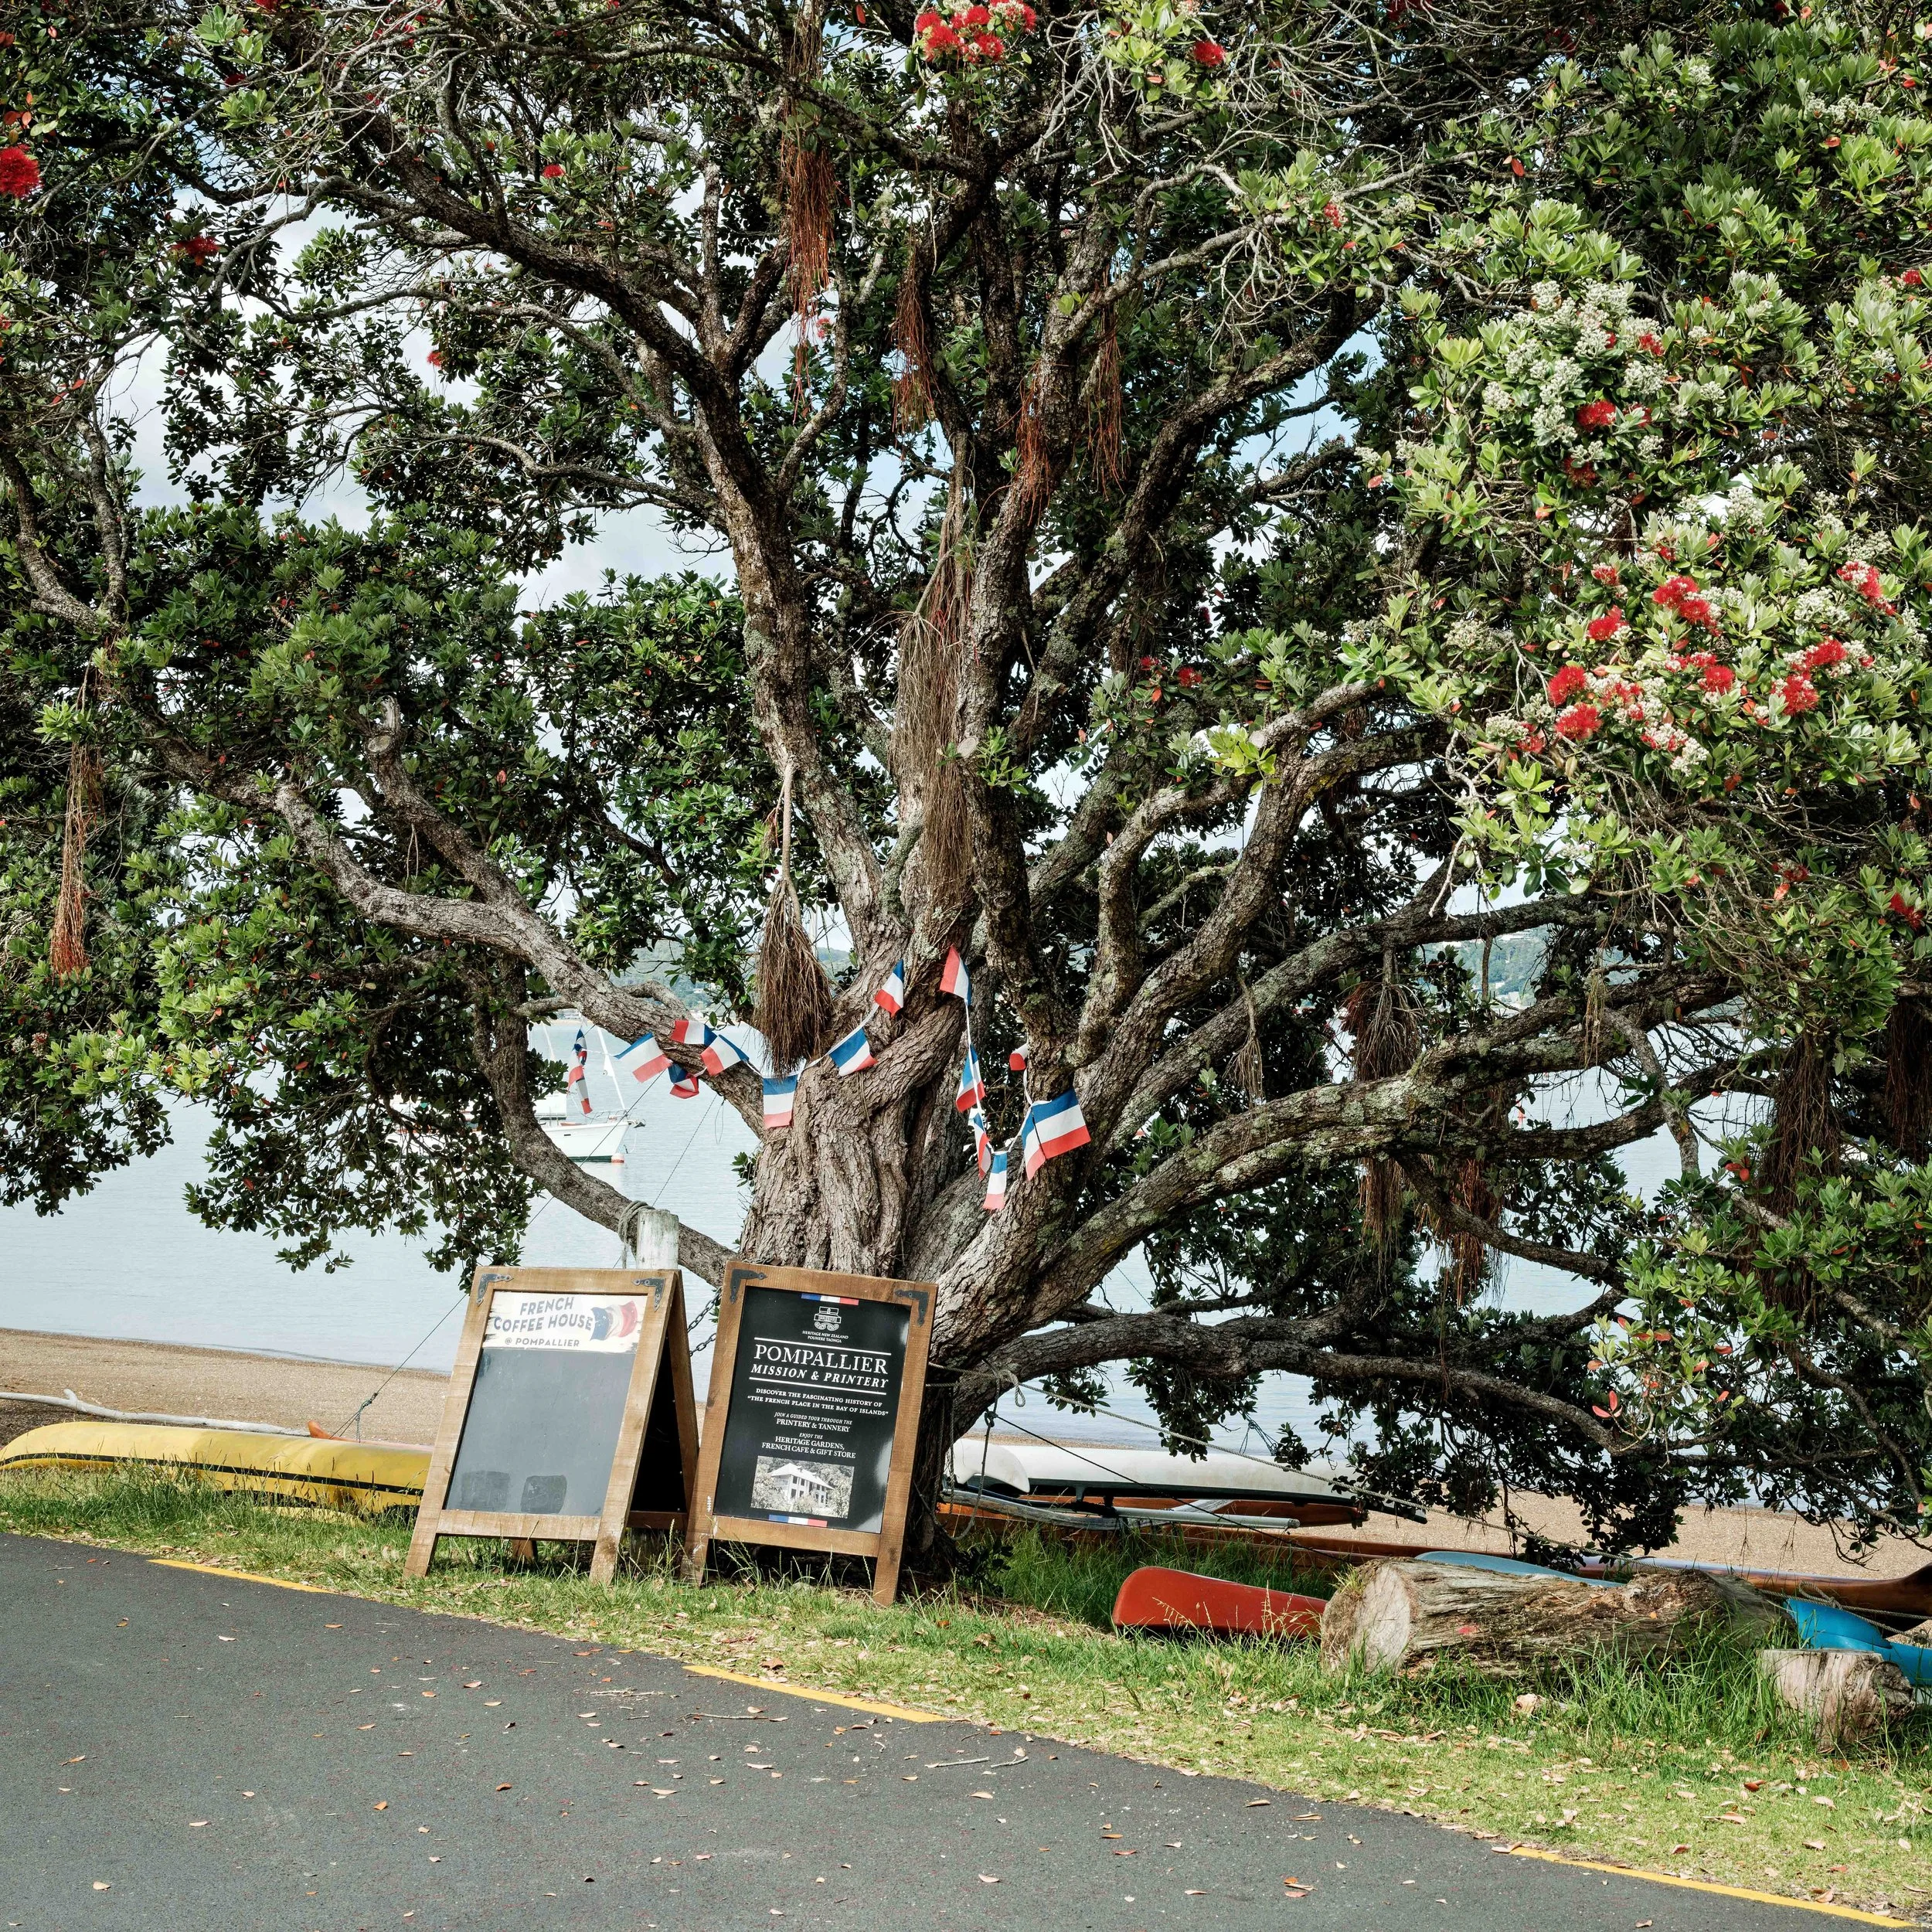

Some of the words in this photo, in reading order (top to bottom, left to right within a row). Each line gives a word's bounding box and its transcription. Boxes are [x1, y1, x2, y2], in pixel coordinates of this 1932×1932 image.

[520, 1297, 574, 1315] FRENCH
[494, 1316, 544, 1332] COFFEE
[548, 1314, 593, 1331] HOUSE
[754, 1344, 888, 1374] POMPALLIER
[751, 1364, 807, 1379] MISSION
[811, 1371, 819, 1380] &
[823, 1372, 889, 1388] PRINTERY
[802, 1393, 843, 1403] FASCINATING
[776, 1418, 811, 1428] PRINTERY
[818, 1423, 850, 1432] TANNERY
[762, 1442, 791, 1451] FRENCH
[775, 1436, 810, 1445] HERITAGE
[811, 1440, 844, 1451] GARDENS,
